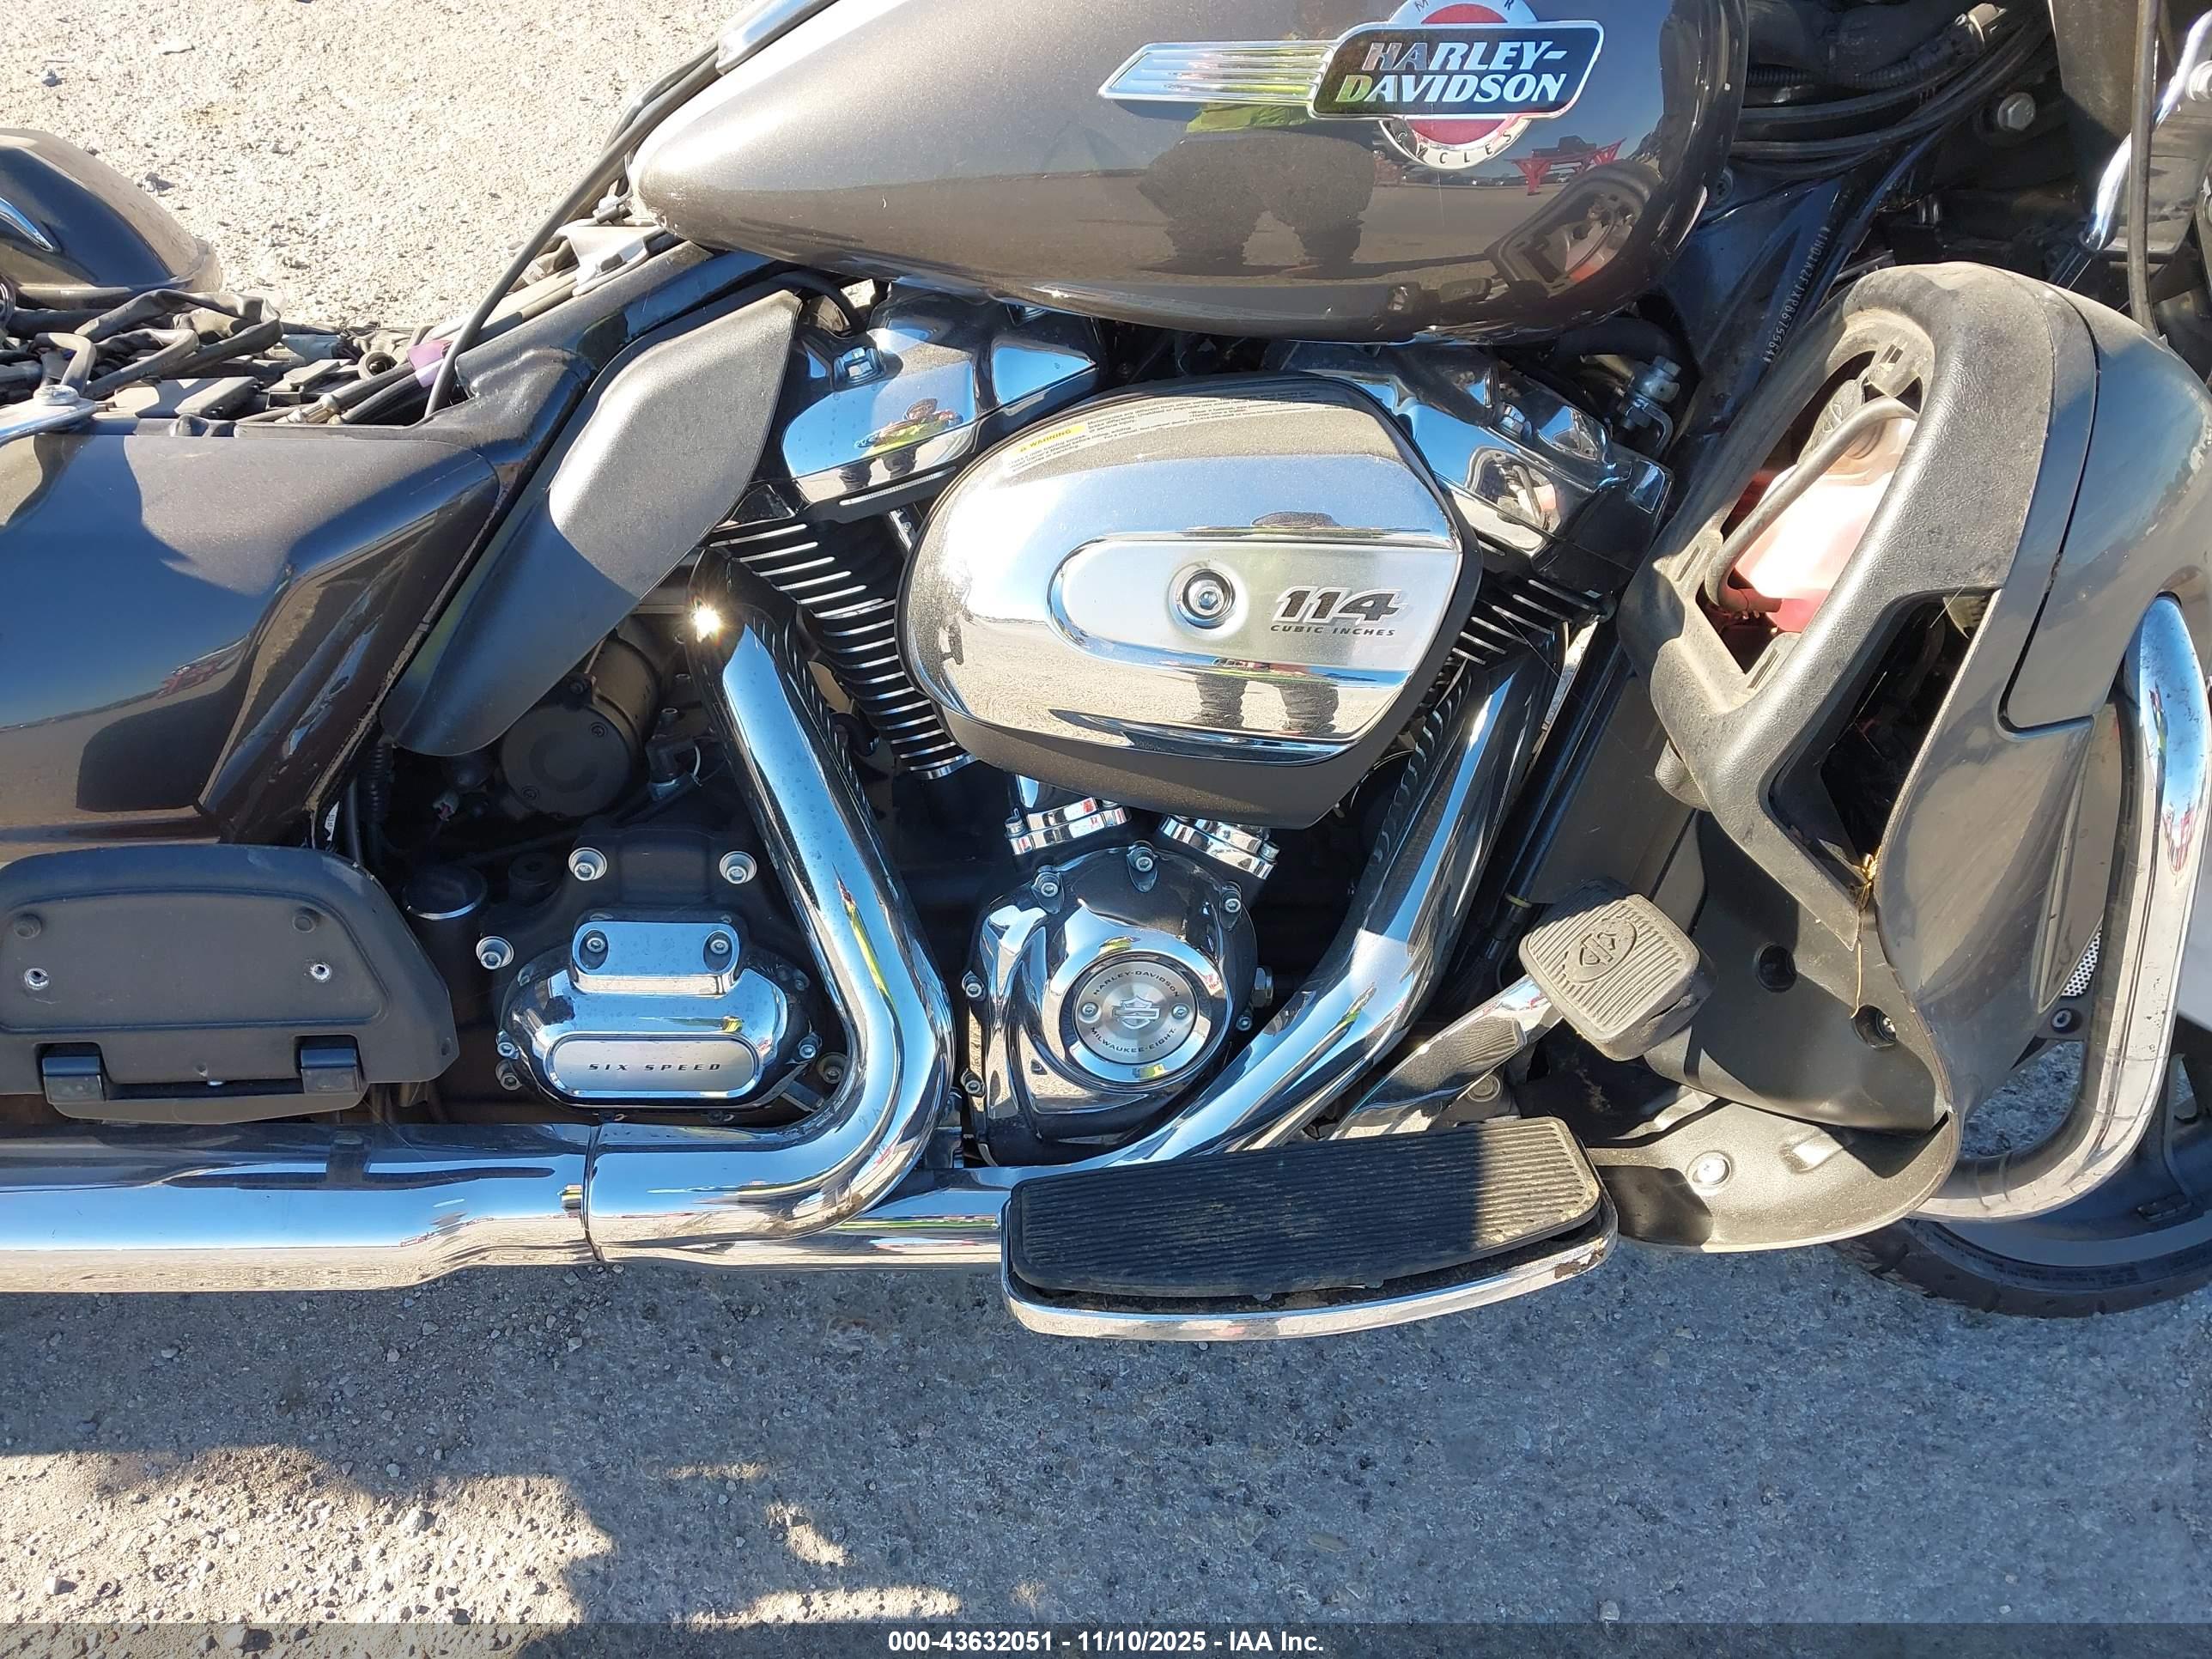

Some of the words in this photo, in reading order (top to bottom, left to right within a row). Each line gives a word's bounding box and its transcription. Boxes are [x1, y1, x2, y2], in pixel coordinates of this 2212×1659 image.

[1361, 40, 1568, 71] HARLEY-
[1334, 74, 1567, 103] DAVIDSON
[1395, 130, 1512, 164] CYCLES
[1273, 586, 1409, 625] 114
[1270, 624, 1324, 634] CUBIC
[1332, 627, 1395, 636] INCHES
[1092, 970, 1180, 997] HARLEY-DAVIDSON
[1090, 1026, 1176, 1053] MILWAUKEE-EIGHT
[587, 1063, 629, 1072] SIX
[644, 1063, 722, 1072] SPEED
